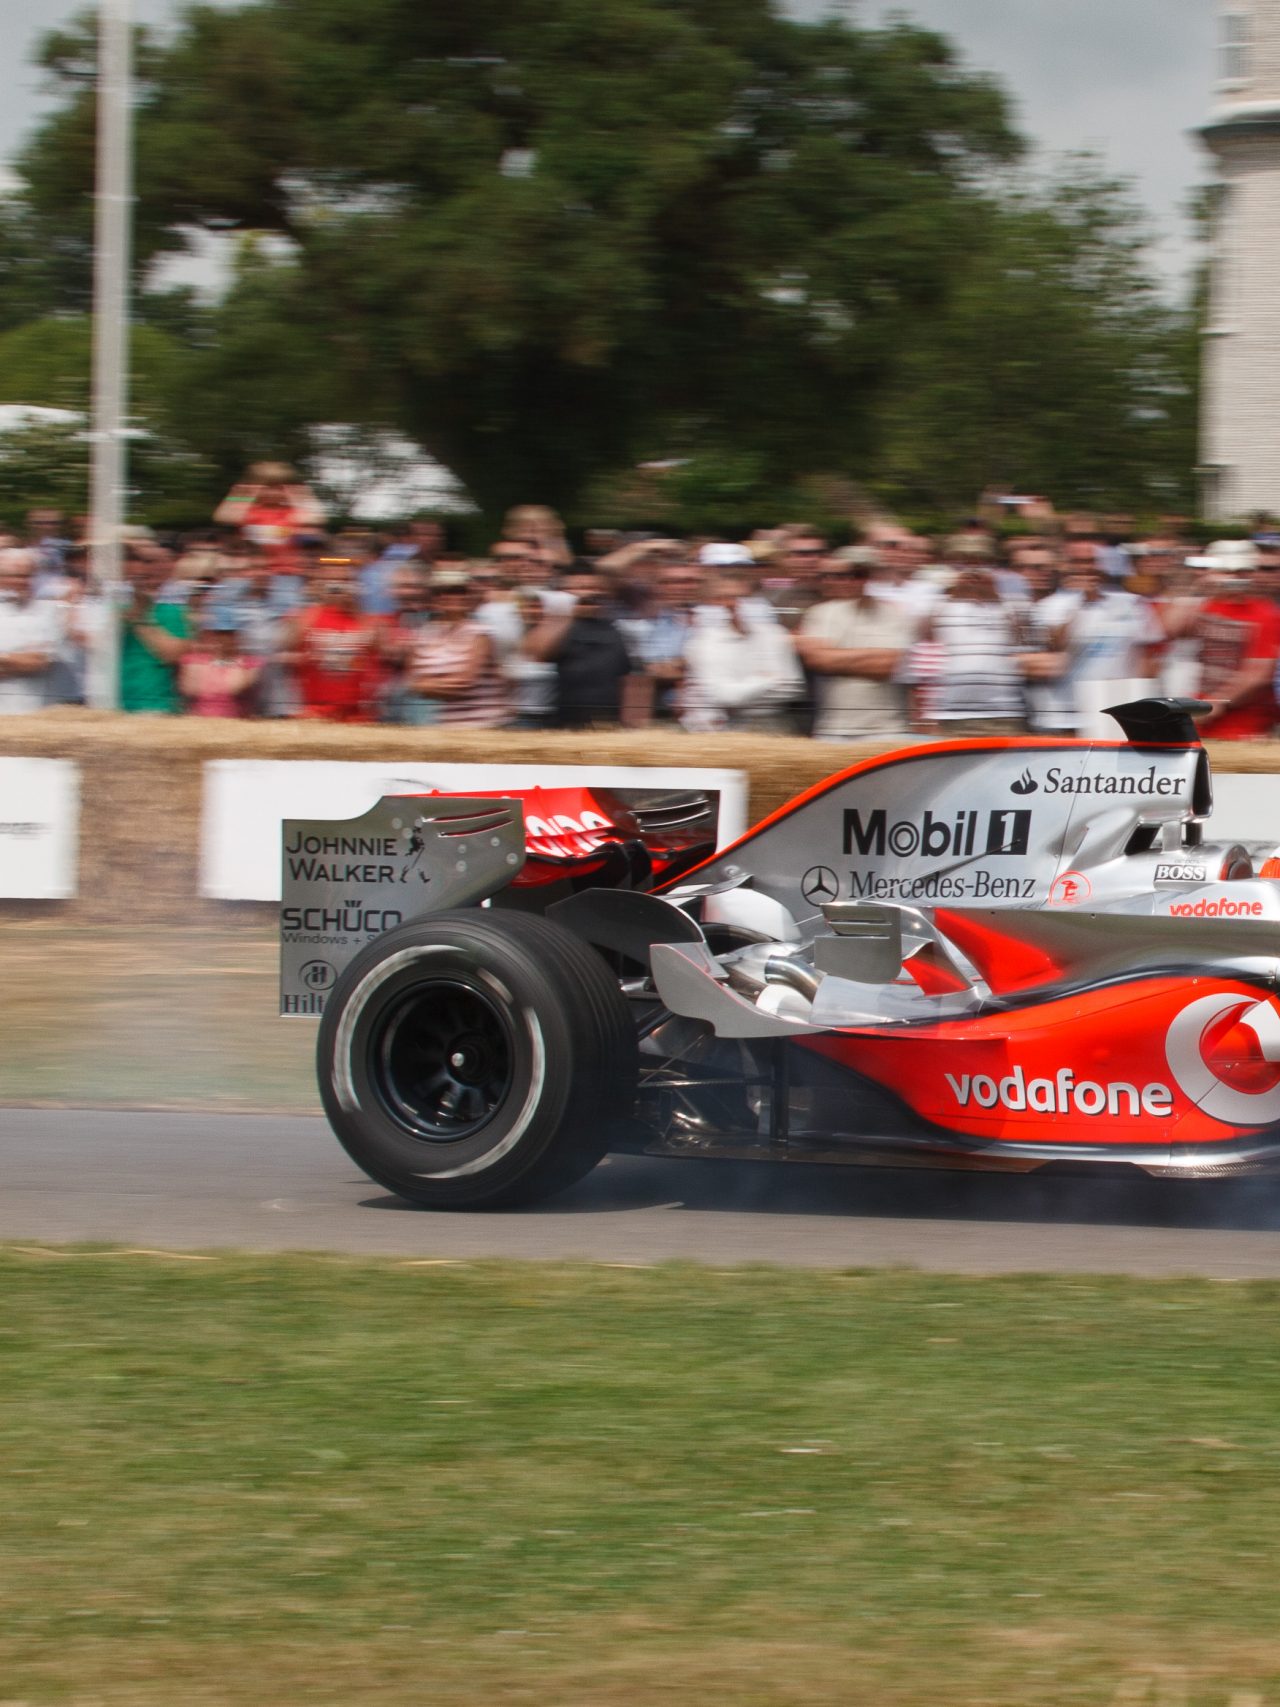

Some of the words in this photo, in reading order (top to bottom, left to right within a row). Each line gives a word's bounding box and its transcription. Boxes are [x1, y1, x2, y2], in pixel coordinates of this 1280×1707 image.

[1043, 766, 1186, 796] Santander
[286, 831, 397, 856] JOHNNIE
[842, 808, 977, 858] Mobil
[288, 858, 394, 883] WALKER
[1156, 865, 1205, 881] BOSS
[849, 870, 1036, 900] Mercedes-Benz
[283, 900, 402, 931] SCHÜCO
[1169, 898, 1263, 917] vodafone
[283, 932, 348, 945] Windows
[283, 993, 324, 1014] Hilt
[945, 1065, 1173, 1117] vodafone
